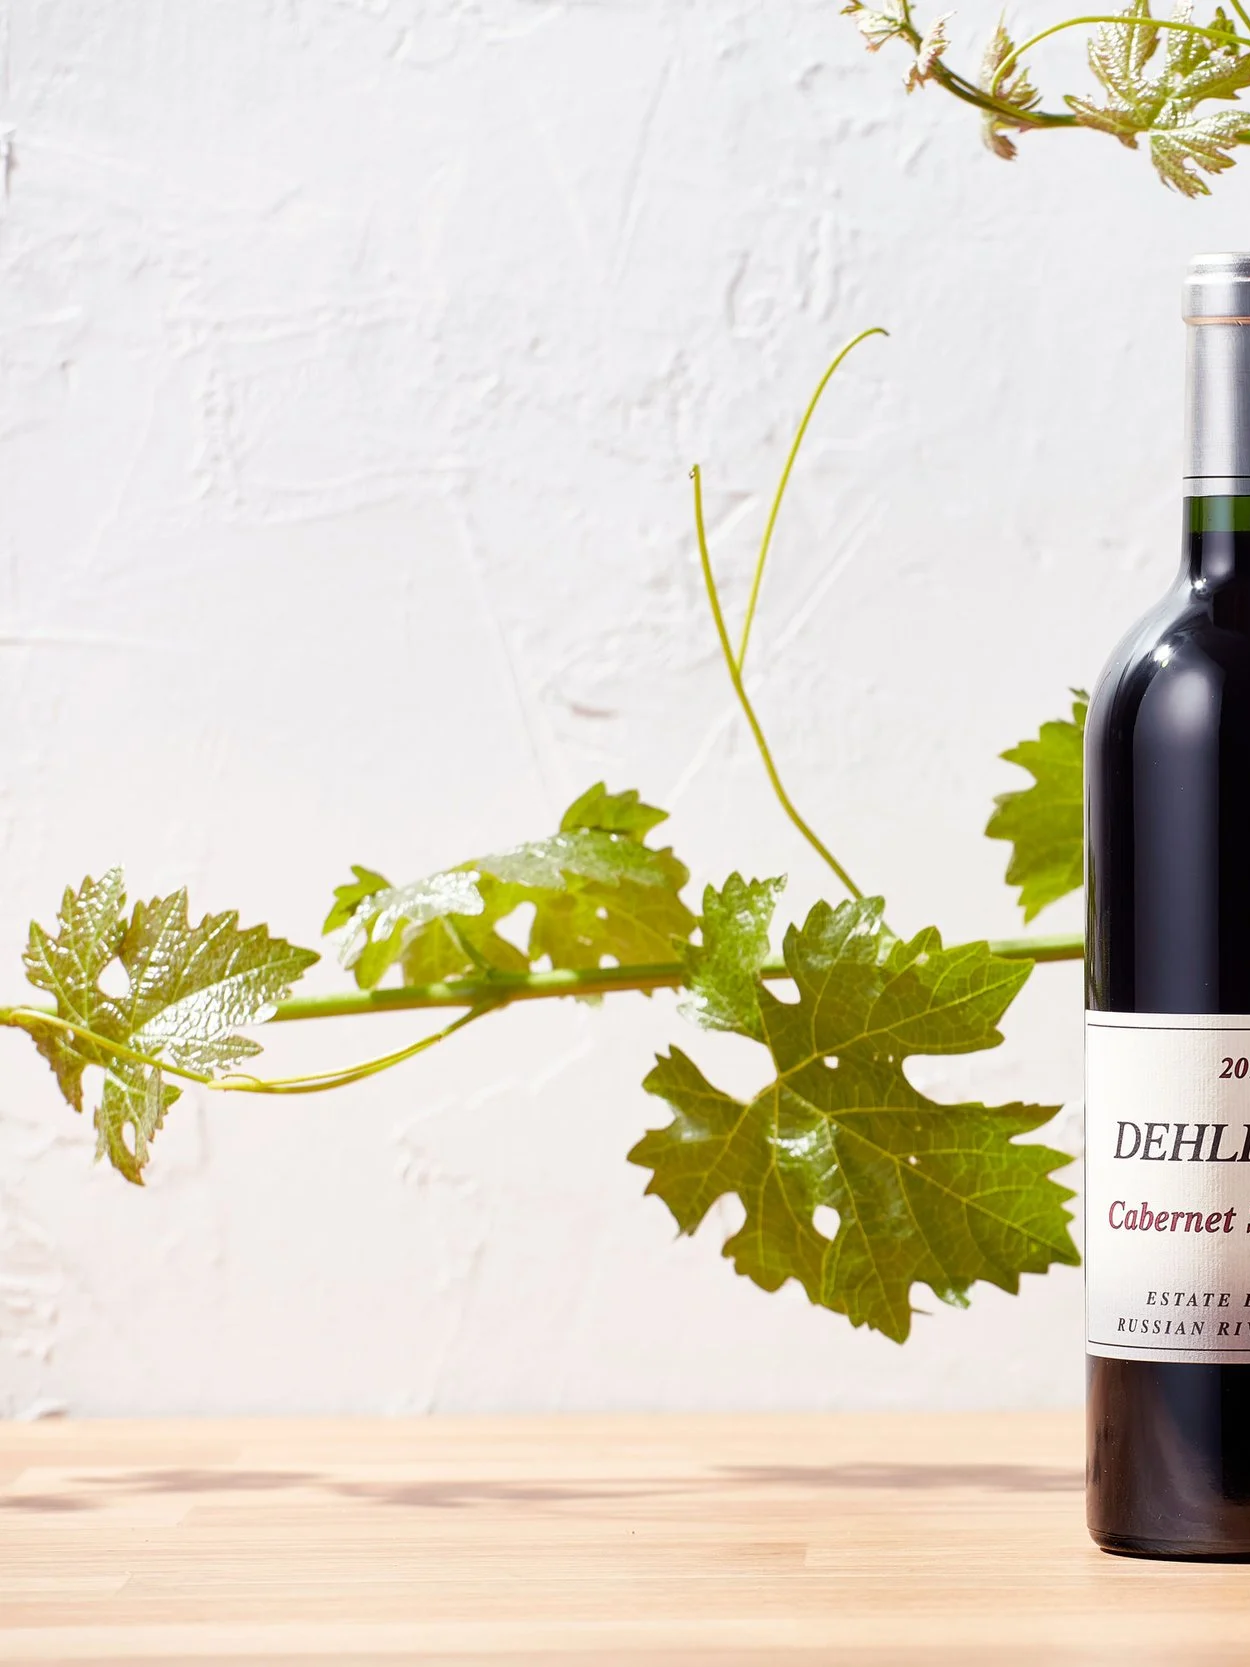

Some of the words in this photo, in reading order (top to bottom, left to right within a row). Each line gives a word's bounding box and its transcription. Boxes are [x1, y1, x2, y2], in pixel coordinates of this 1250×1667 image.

[1109, 1200, 1237, 1233] Cabernet
[1146, 1291, 1230, 1308] ESTATE
[1117, 1317, 1206, 1336] RUSSIAN
